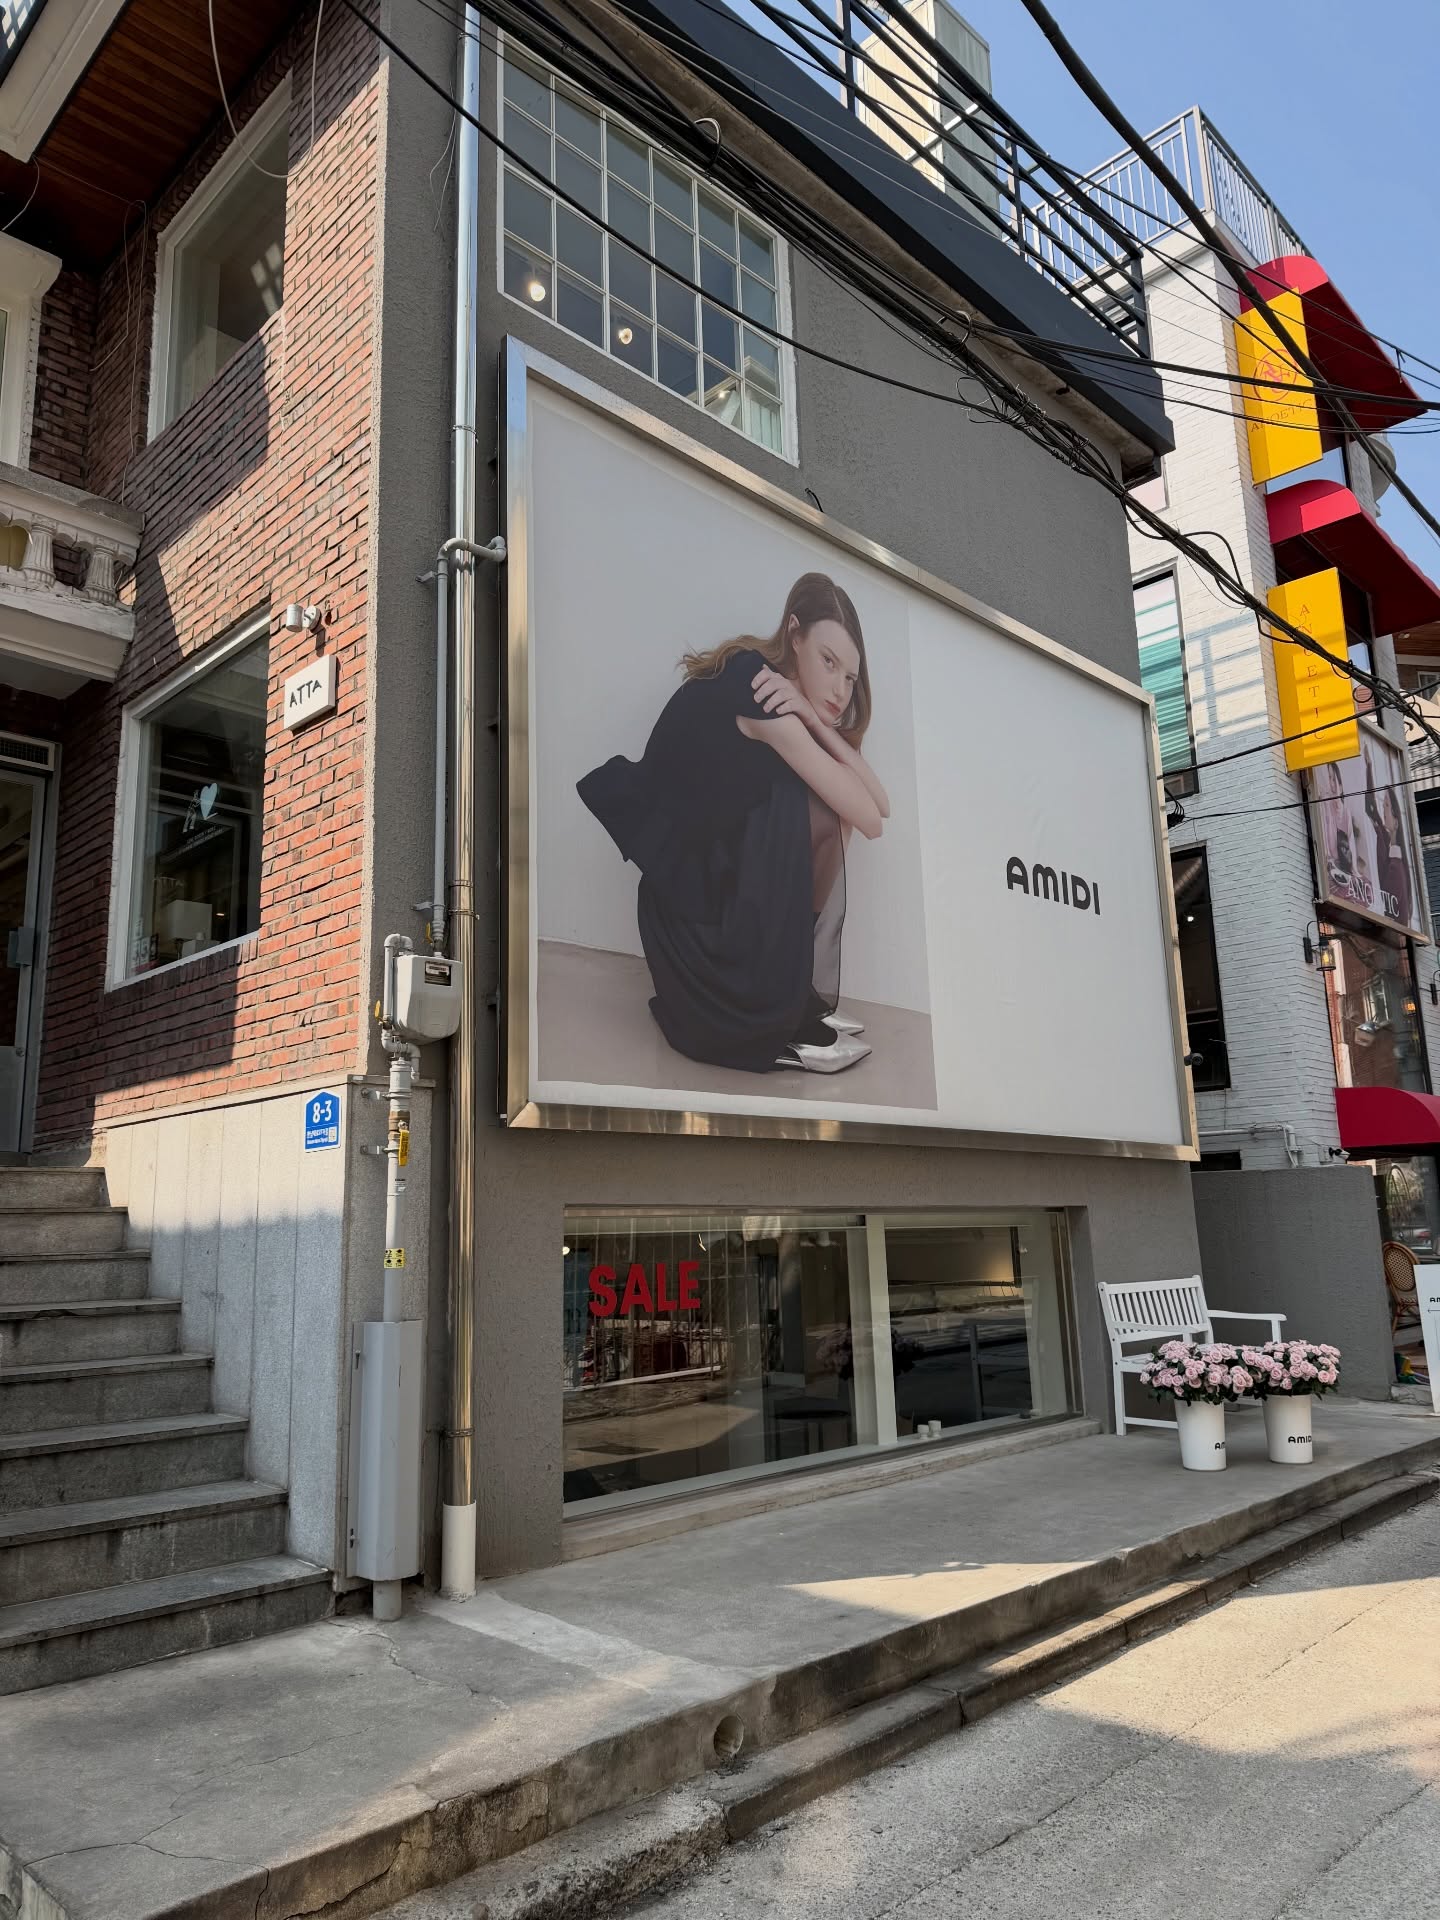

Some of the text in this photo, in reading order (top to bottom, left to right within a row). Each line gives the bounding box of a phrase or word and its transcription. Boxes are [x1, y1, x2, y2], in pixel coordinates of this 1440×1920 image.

[1251, 398, 1312, 432] AOETIC
[289, 679, 322, 708] ATTA
[1006, 856, 1101, 916] AMIDI
[1346, 876, 1400, 918] ANOTIC
[312, 1099, 332, 1124] 8-3
[588, 1261, 701, 1317] SALE
